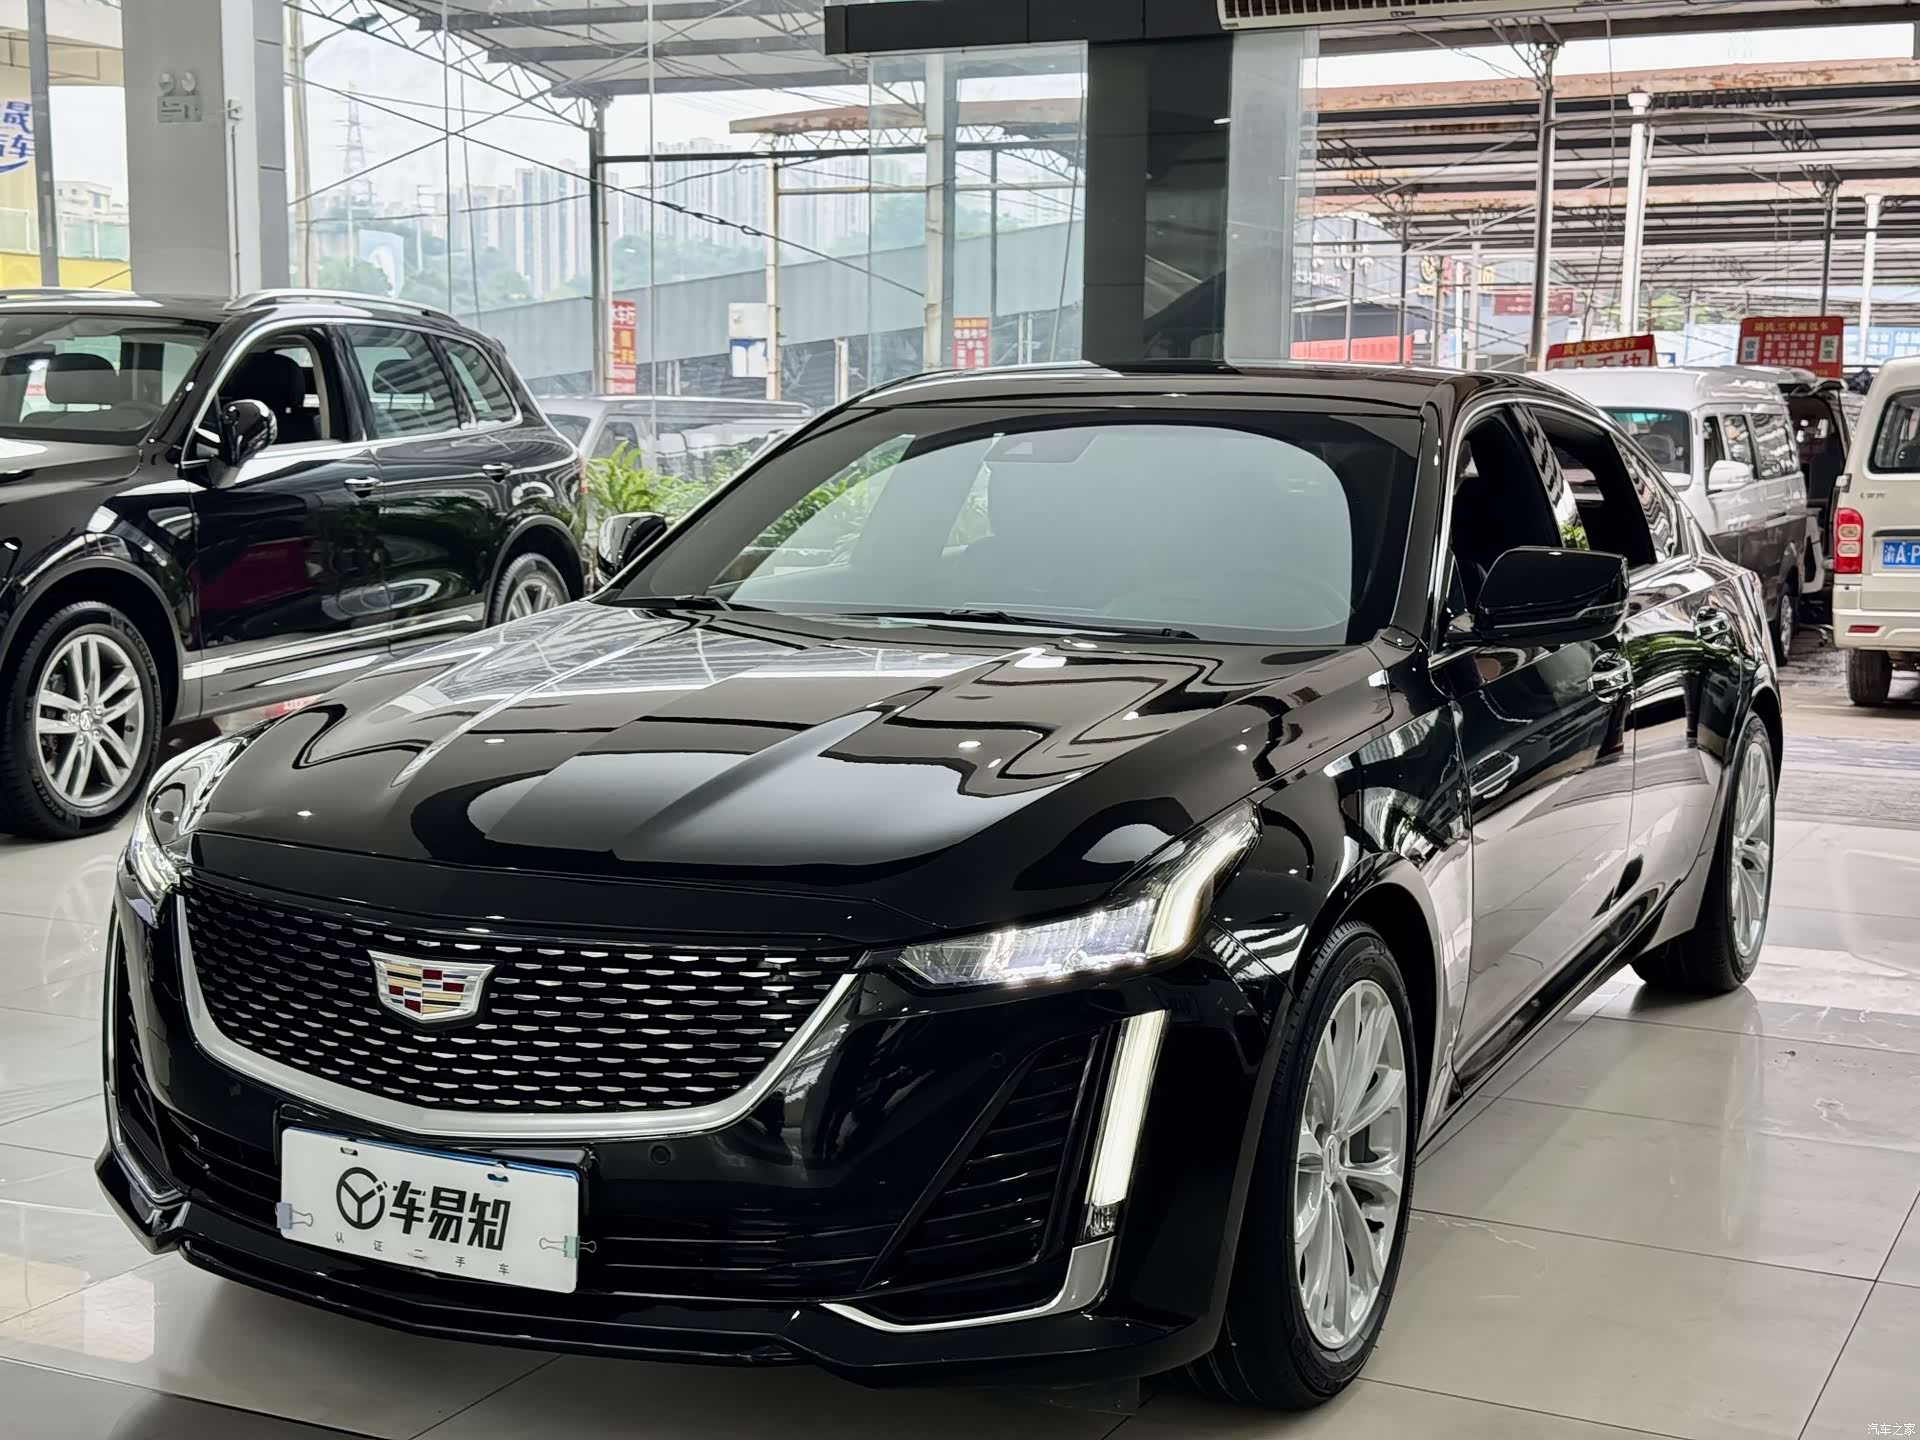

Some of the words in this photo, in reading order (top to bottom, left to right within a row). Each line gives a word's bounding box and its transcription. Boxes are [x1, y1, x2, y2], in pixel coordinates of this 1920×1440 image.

[389, 1179, 512, 1252] 车易知
[334, 1231, 510, 1276] 认证二手车
